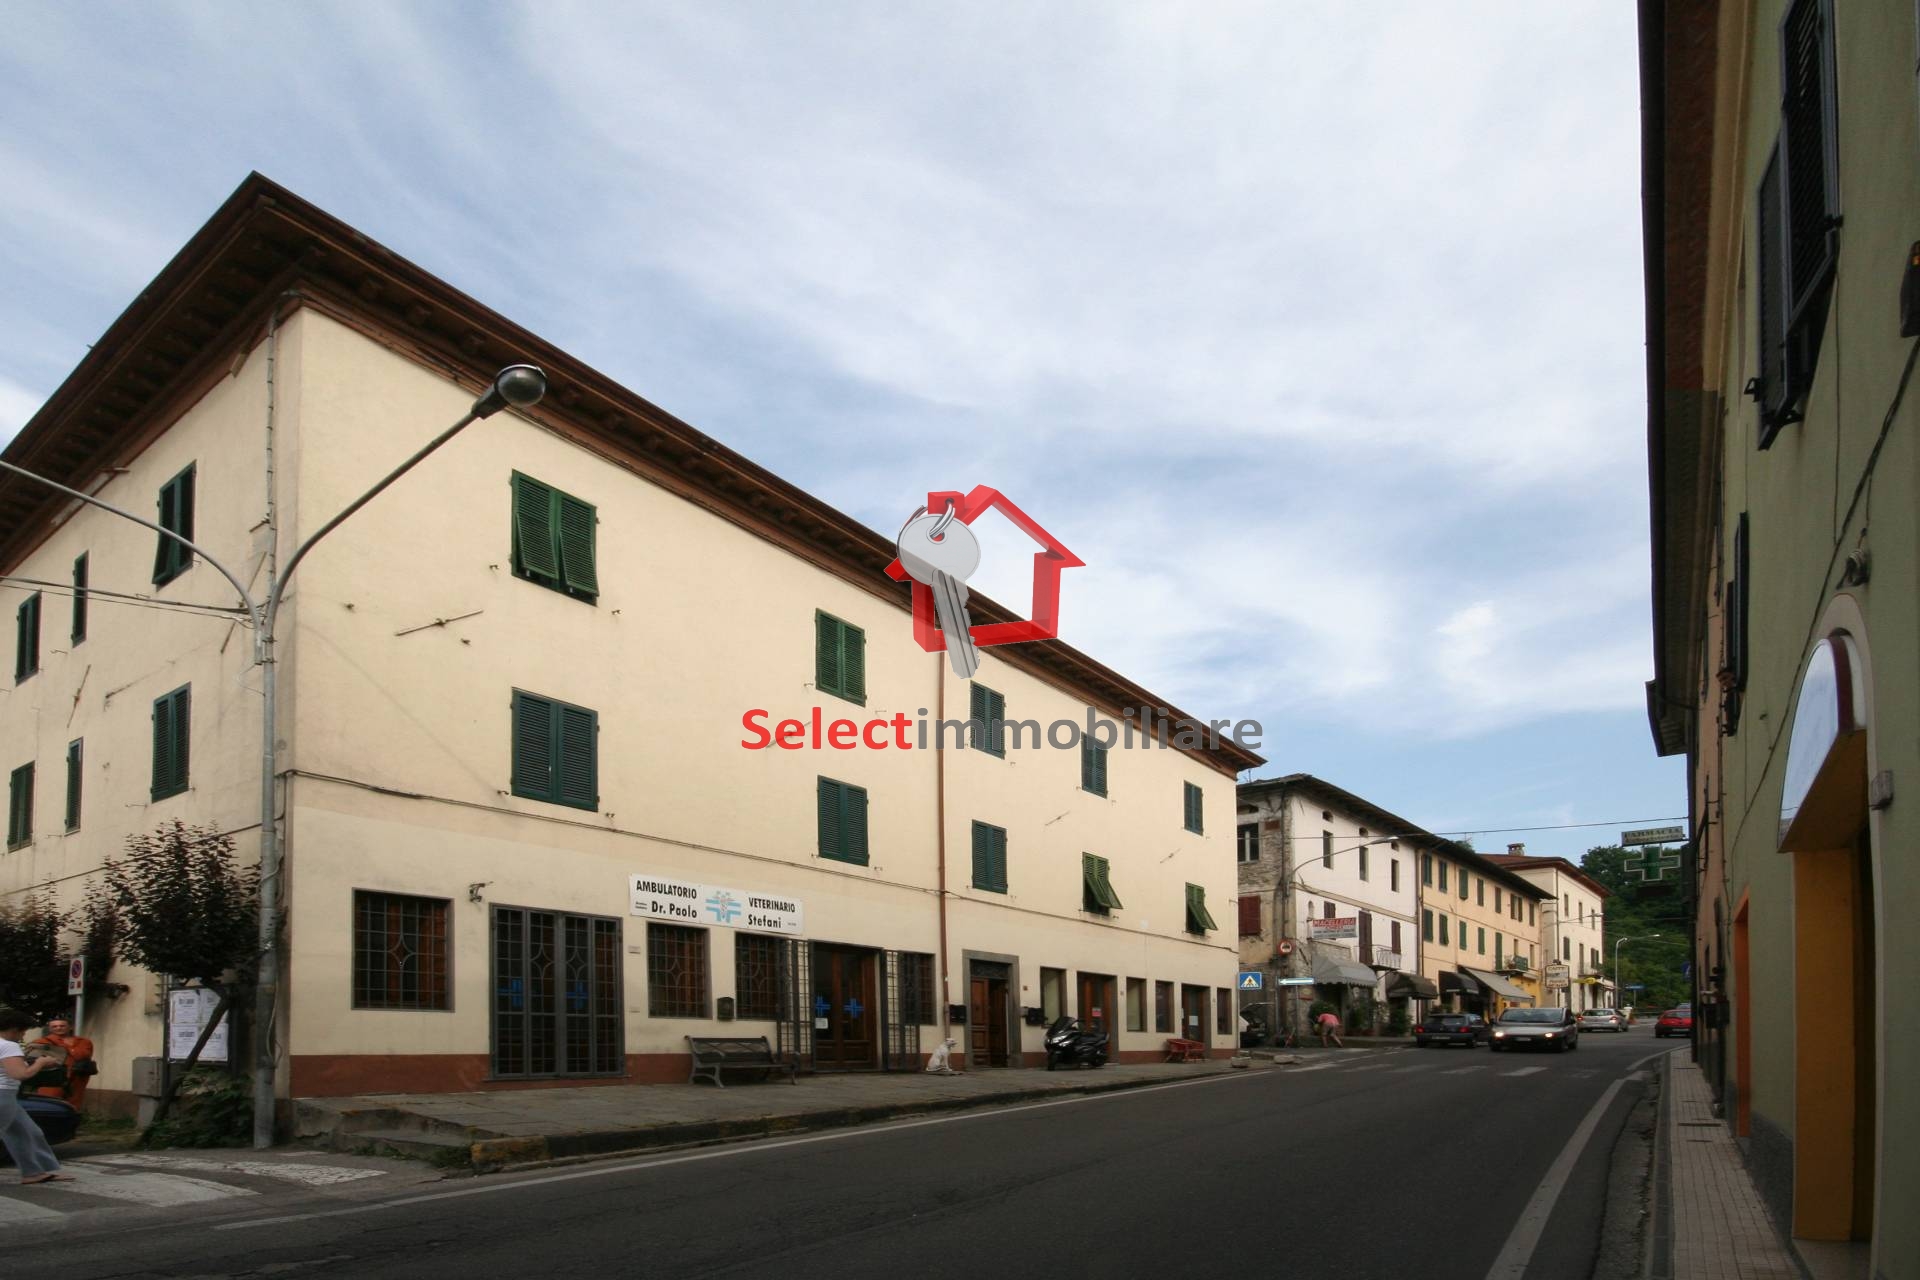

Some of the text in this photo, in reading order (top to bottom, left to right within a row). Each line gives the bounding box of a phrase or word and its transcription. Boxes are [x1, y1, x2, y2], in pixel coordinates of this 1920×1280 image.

[636, 880, 697, 900] AMBULATORIO
[651, 900, 698, 918] Dr. Paolo
[748, 897, 796, 913] VETERINARIO
[748, 913, 782, 929] Stefani
